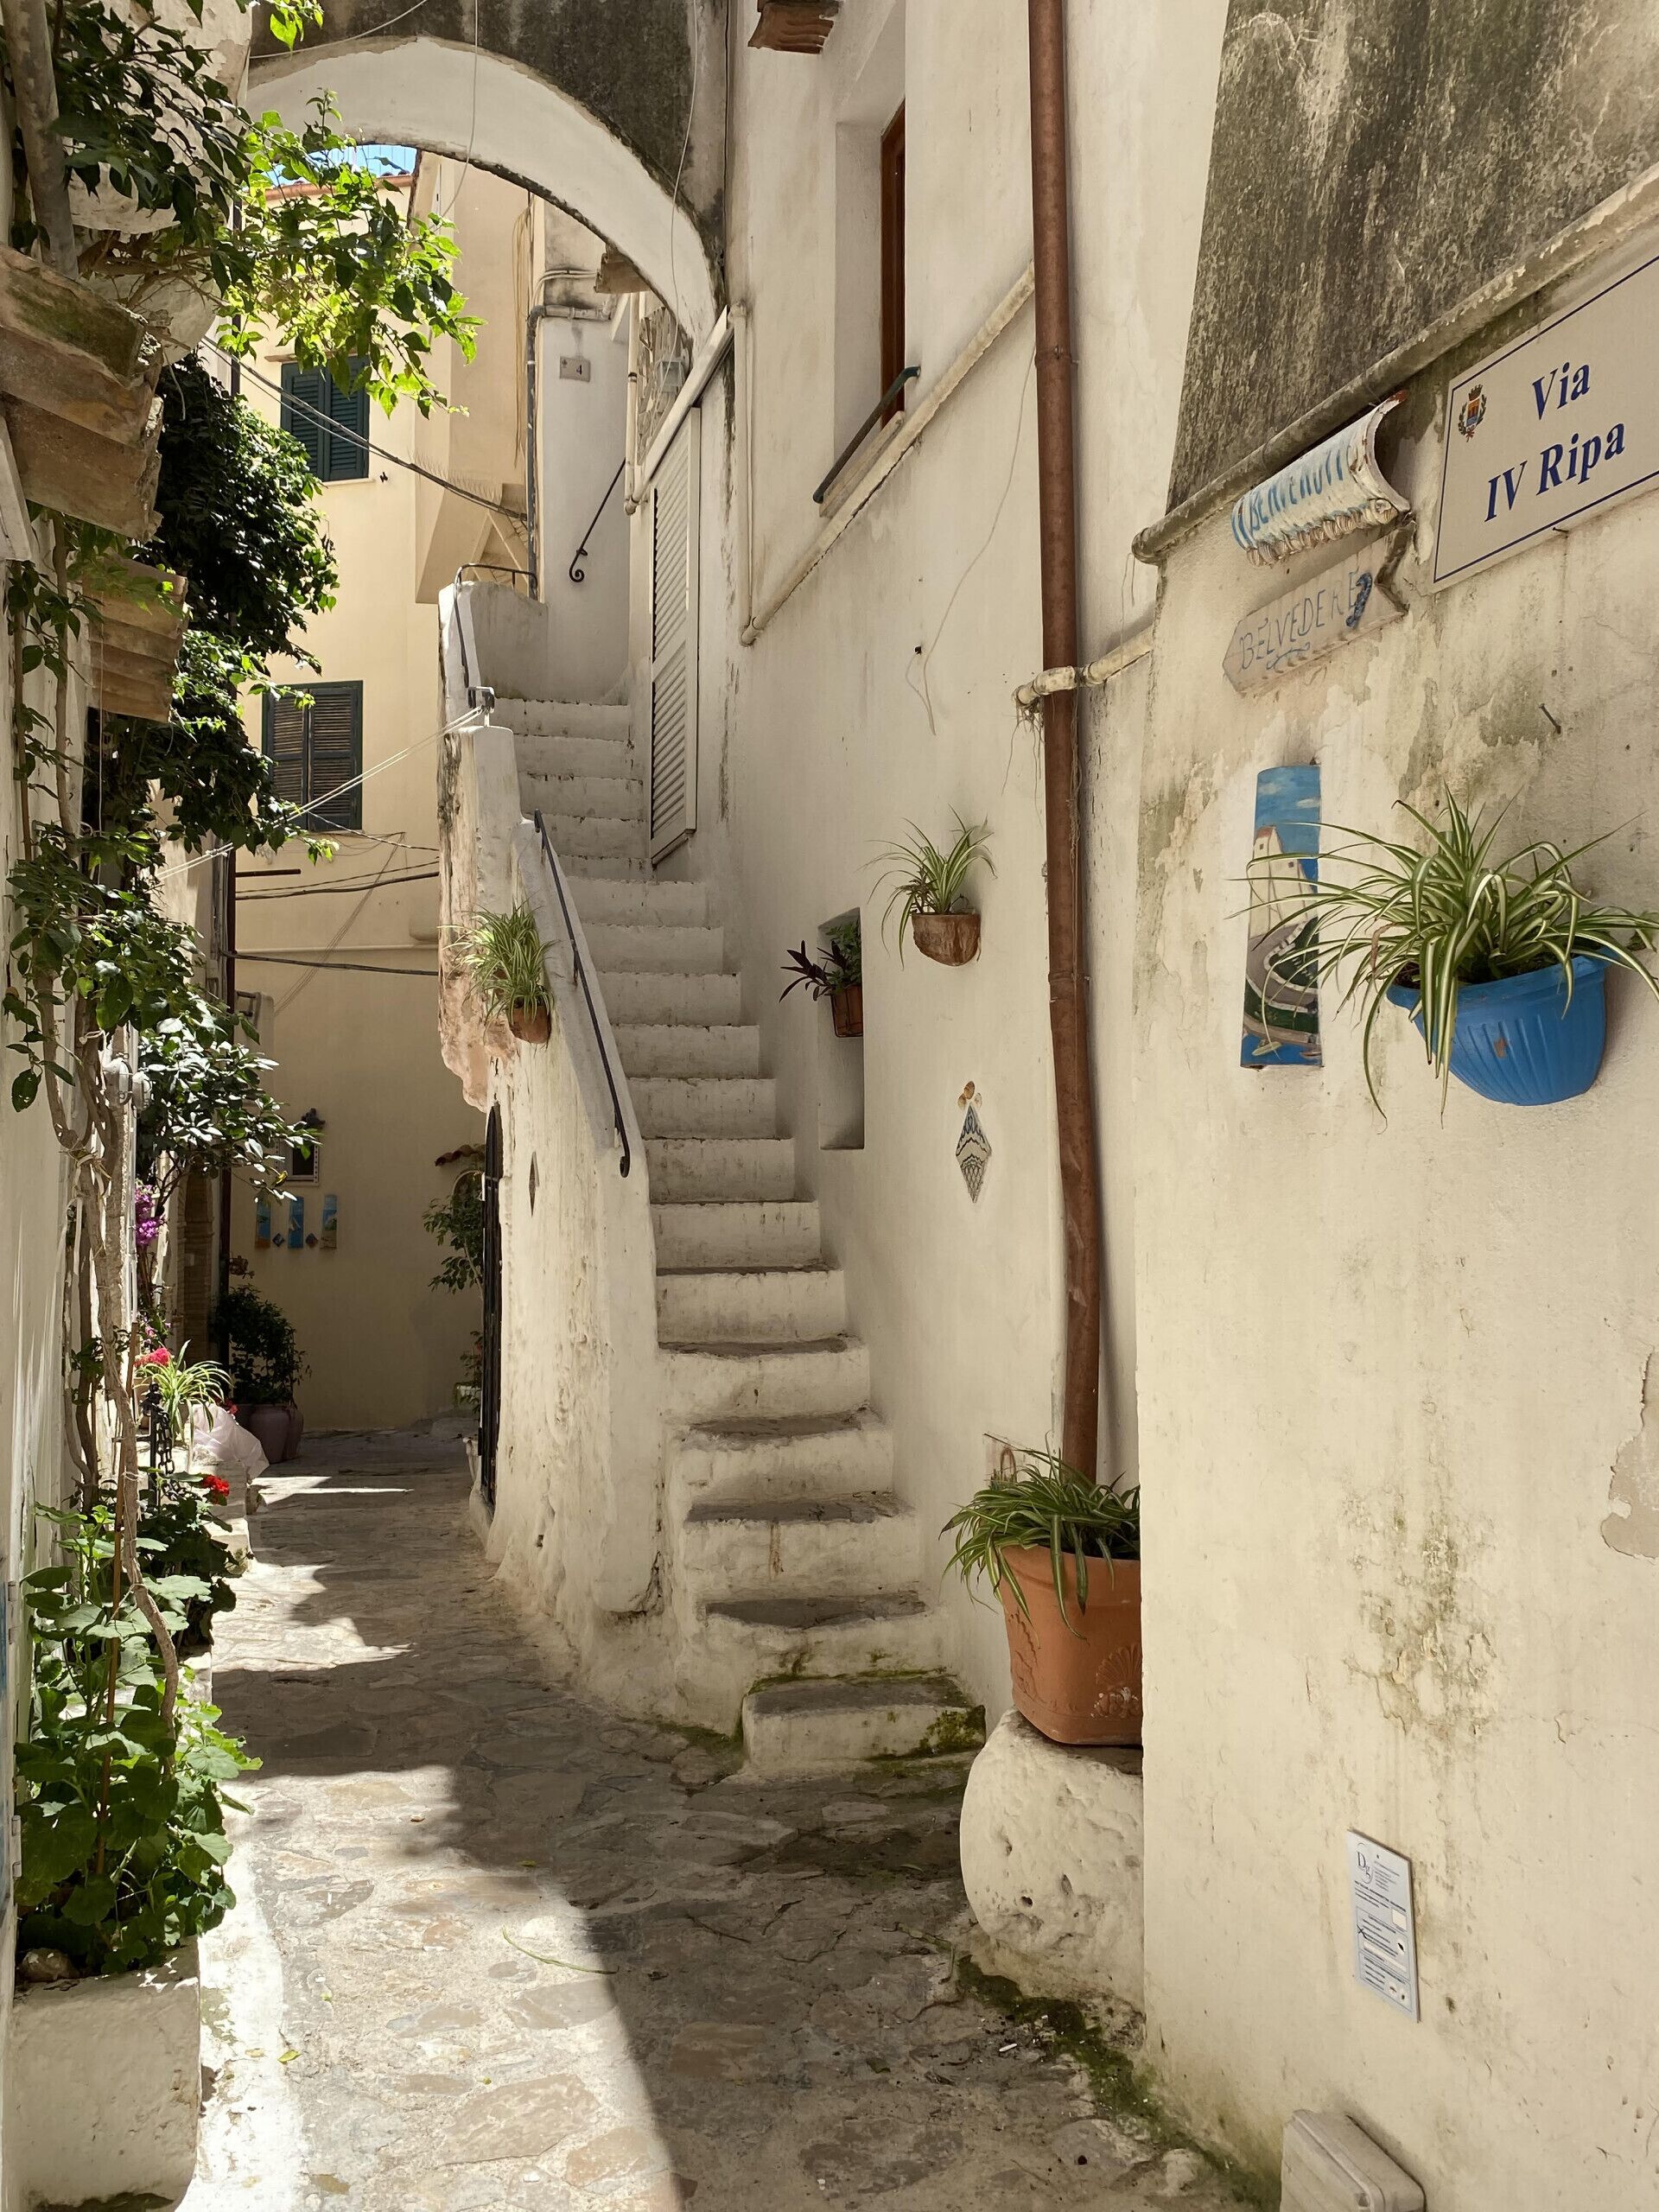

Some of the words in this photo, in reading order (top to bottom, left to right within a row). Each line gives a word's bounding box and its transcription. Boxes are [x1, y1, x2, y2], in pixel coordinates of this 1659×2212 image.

[575, 364, 582, 375] 4
[1532, 362, 1590, 420] Via
[1484, 460, 1528, 522] IV
[1536, 423, 1625, 495] Ripa
[1239, 567, 1359, 671] BELVEDERE
